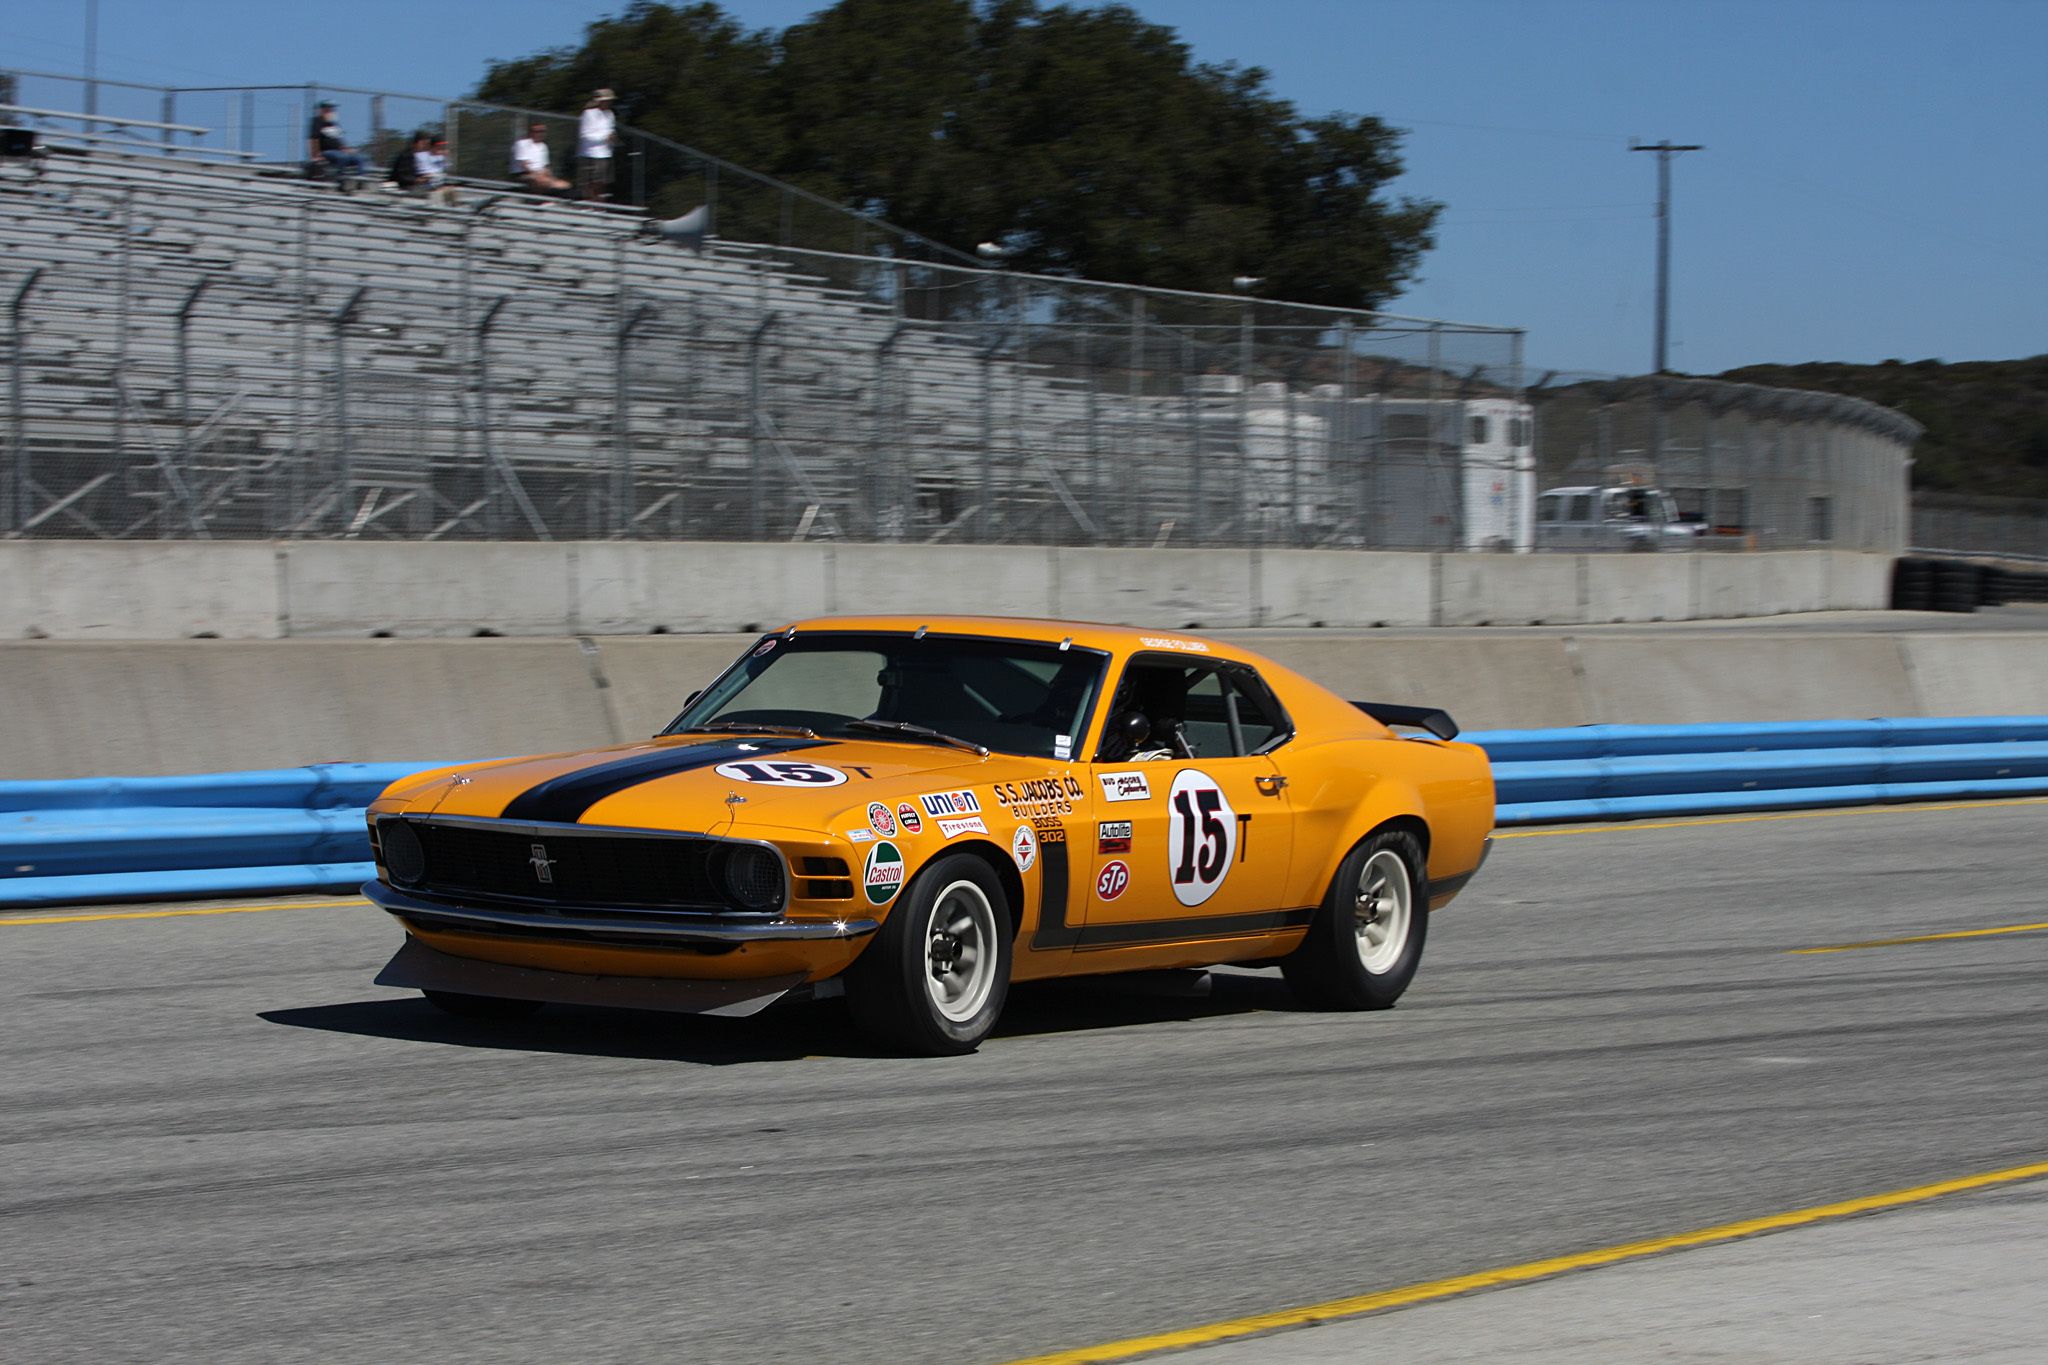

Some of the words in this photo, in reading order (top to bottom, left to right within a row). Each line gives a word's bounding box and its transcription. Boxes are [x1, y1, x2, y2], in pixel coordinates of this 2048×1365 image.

[727, 764, 835, 782] 15
[840, 766, 873, 779] T
[921, 791, 979, 815] UNION
[954, 797, 964, 807] 76
[1012, 801, 1073, 819] BUILDERS
[942, 821, 982, 833] Firestone
[1031, 817, 1063, 828] BOSS
[1101, 824, 1130, 837] Autolite
[1039, 831, 1065, 842] 302
[1174, 789, 1227, 884] 15
[1237, 814, 1251, 863] T
[869, 865, 903, 883] Castrol
[1099, 865, 1127, 895] STP
